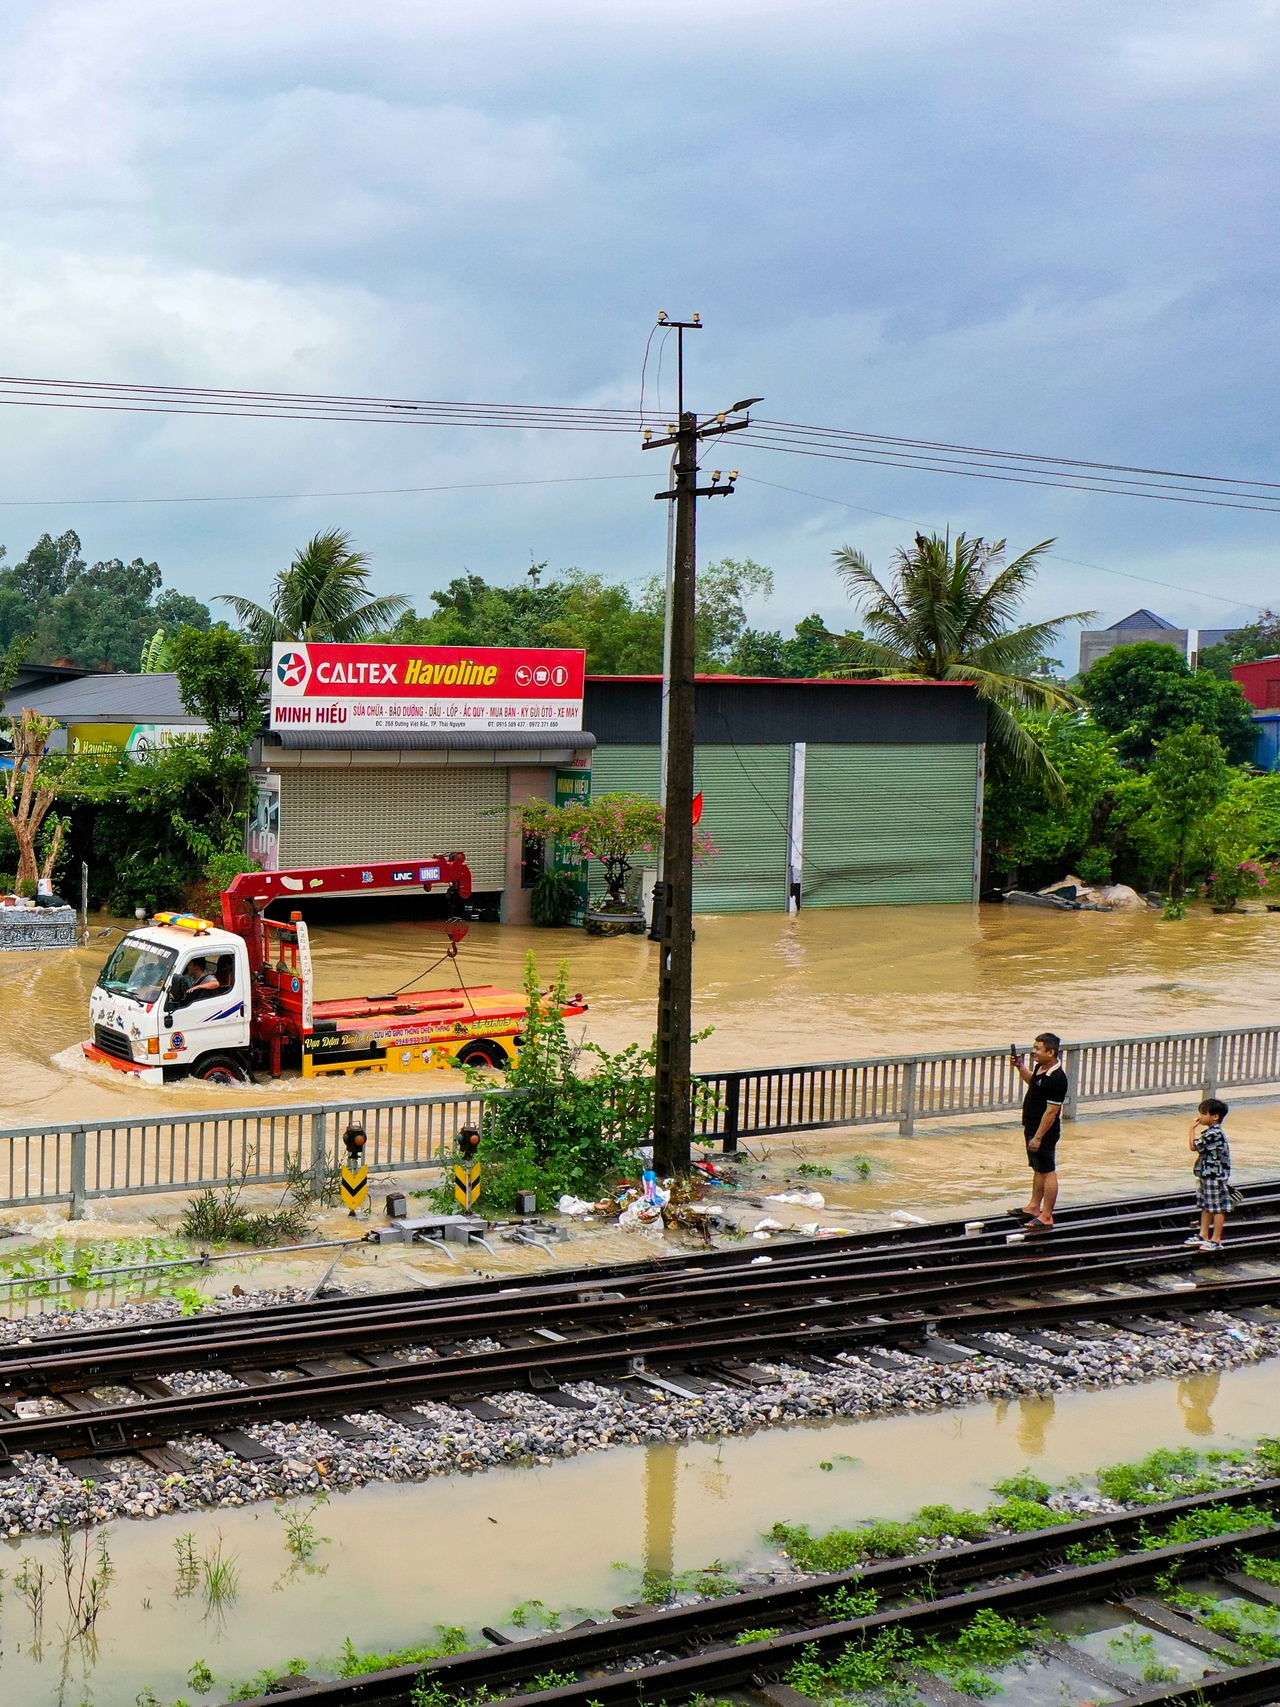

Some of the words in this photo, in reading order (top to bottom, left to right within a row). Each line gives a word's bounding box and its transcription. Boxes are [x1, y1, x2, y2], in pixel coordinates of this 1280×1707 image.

[316, 661, 398, 685] CALTEX
[404, 659, 498, 687] Havoline
[275, 706, 311, 723] MINH
[315, 701, 347, 724] HIẾU
[353, 703, 366, 717] SỬA
[367, 704, 384, 717] CHỮA
[389, 703, 401, 717] BẢO
[403, 704, 424, 718] DƯỠNG
[446, 703, 459, 718] LỐP
[472, 707, 485, 718] QUY
[489, 706, 503, 718] MUA
[504, 704, 516, 718] BÁN
[521, 704, 529, 718] KÝ
[557, 707, 565, 718] XE
[566, 704, 579, 718] MÁY
[394, 872, 413, 881] UNIC
[421, 868, 439, 880] UNIC
[305, 1038, 320, 1050] Vạn
